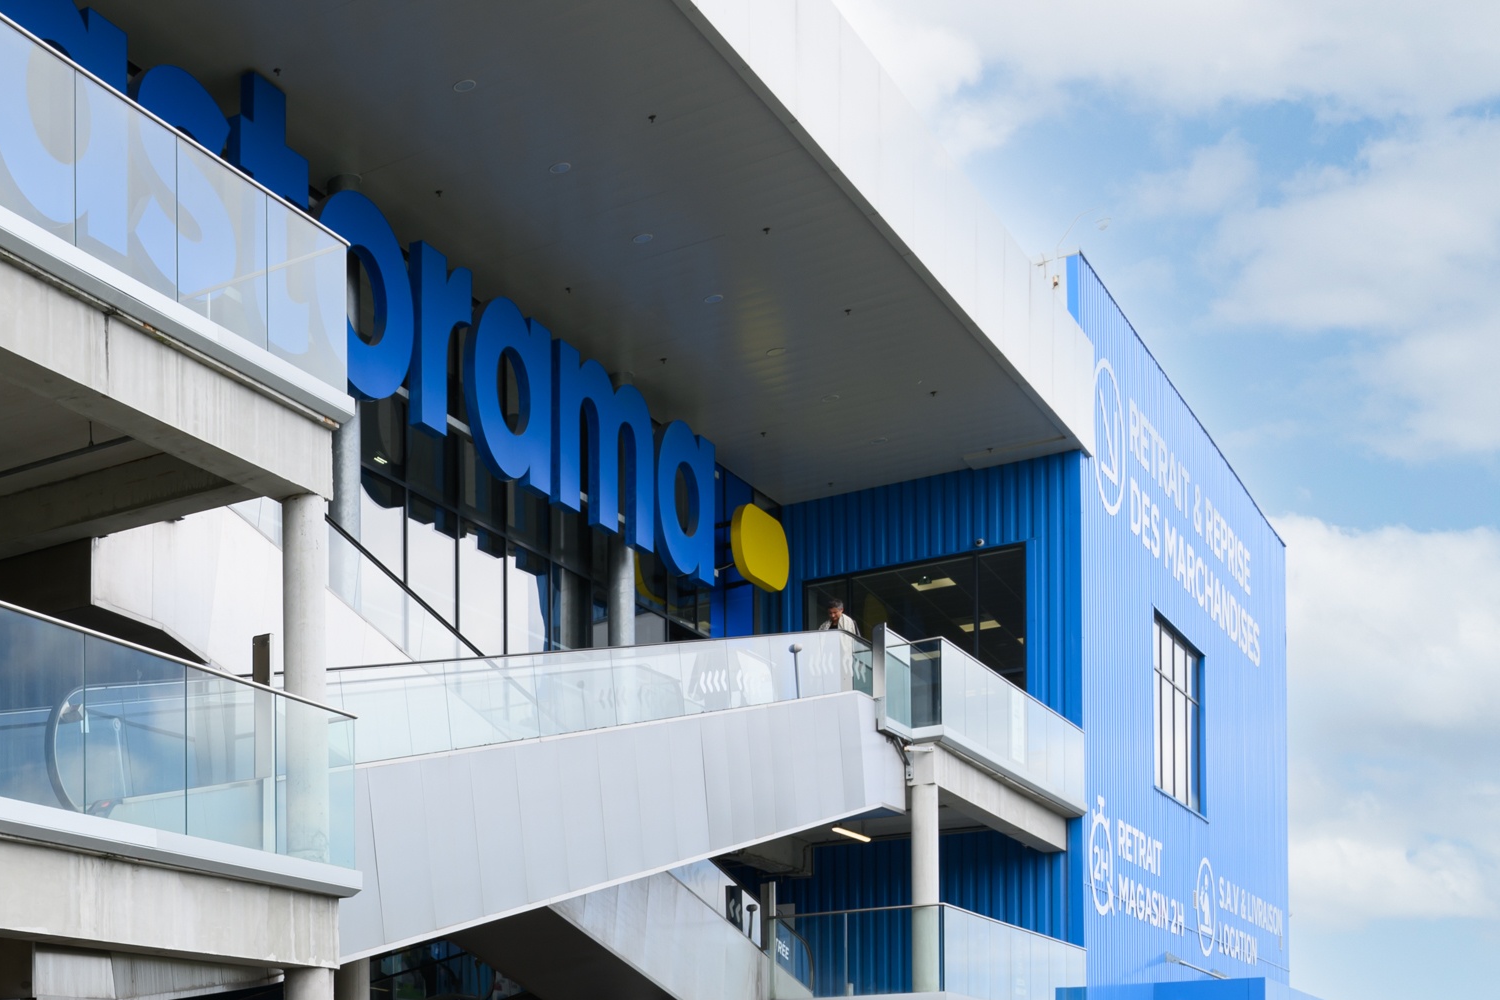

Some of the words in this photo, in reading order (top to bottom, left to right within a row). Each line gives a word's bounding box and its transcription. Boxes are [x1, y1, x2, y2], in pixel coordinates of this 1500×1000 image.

[1129, 397, 1190, 519] RETRAIT
[1193, 484, 1203, 537] &
[1205, 496, 1250, 597] REPRISE
[1130, 476, 1160, 560] DES
[1164, 516, 1260, 667] MARCHANDISES
[1093, 845, 1109, 882] 2H
[1117, 818, 1163, 877] RETRAIT
[1118, 873, 1169, 931] MAGASIN
[1170, 899, 1184, 936] 2H
[1241, 889, 1247, 920] &
[1248, 892, 1283, 937] LIVRAISON
[1218, 921, 1257, 966] LOCATION
